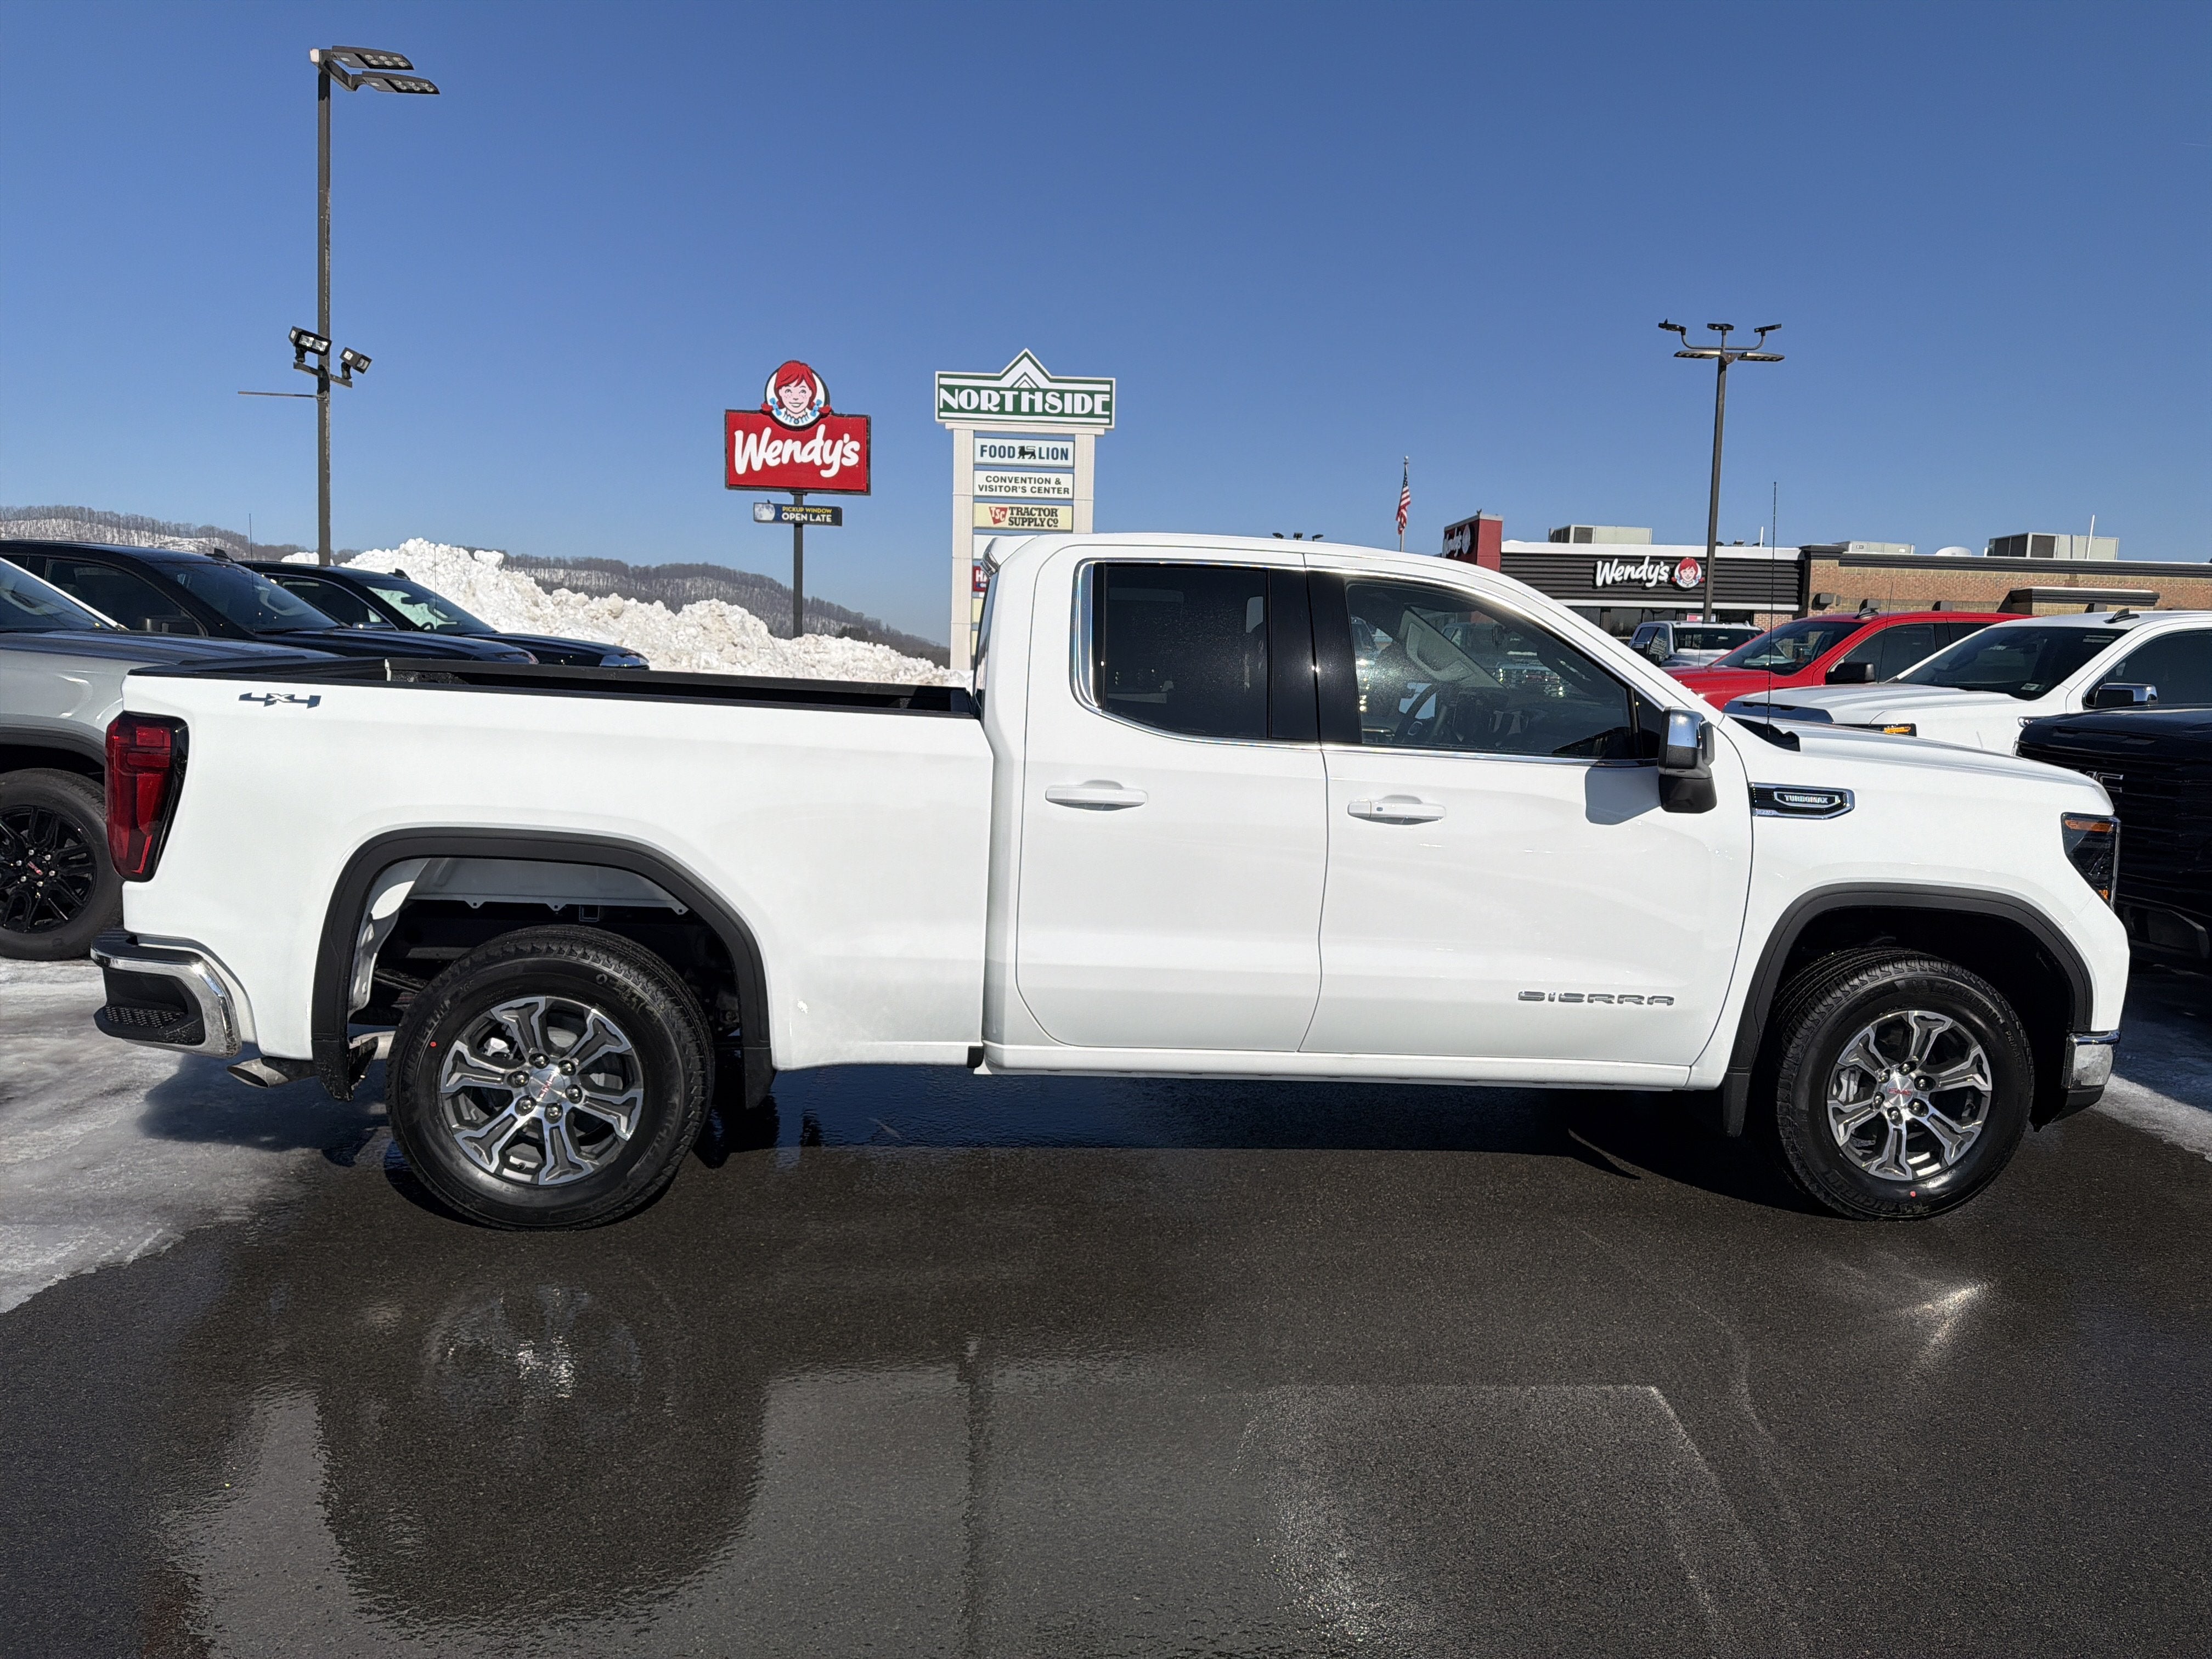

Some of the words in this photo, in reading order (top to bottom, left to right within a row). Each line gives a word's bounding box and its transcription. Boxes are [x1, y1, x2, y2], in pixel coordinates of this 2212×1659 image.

[939, 388, 1110, 415] NORTHSIDE
[735, 424, 860, 477] Wendy's
[980, 444, 1015, 458] FOOD
[1039, 447, 1069, 460] LION
[985, 476, 1051, 484] CONVENTION
[978, 484, 1027, 493] VISITOR'S
[1030, 486, 1069, 494] CENTER
[781, 512, 808, 521] OPEN
[809, 514, 832, 522] LATE
[990, 507, 1006, 522] TSC
[1008, 506, 1058, 517] TRACTOR
[1008, 517, 1046, 527] SUPPLY
[1596, 556, 1670, 588] Wendy's
[1785, 794, 1829, 804] TURBOMAX
[1517, 991, 1675, 1006] SIERRA
